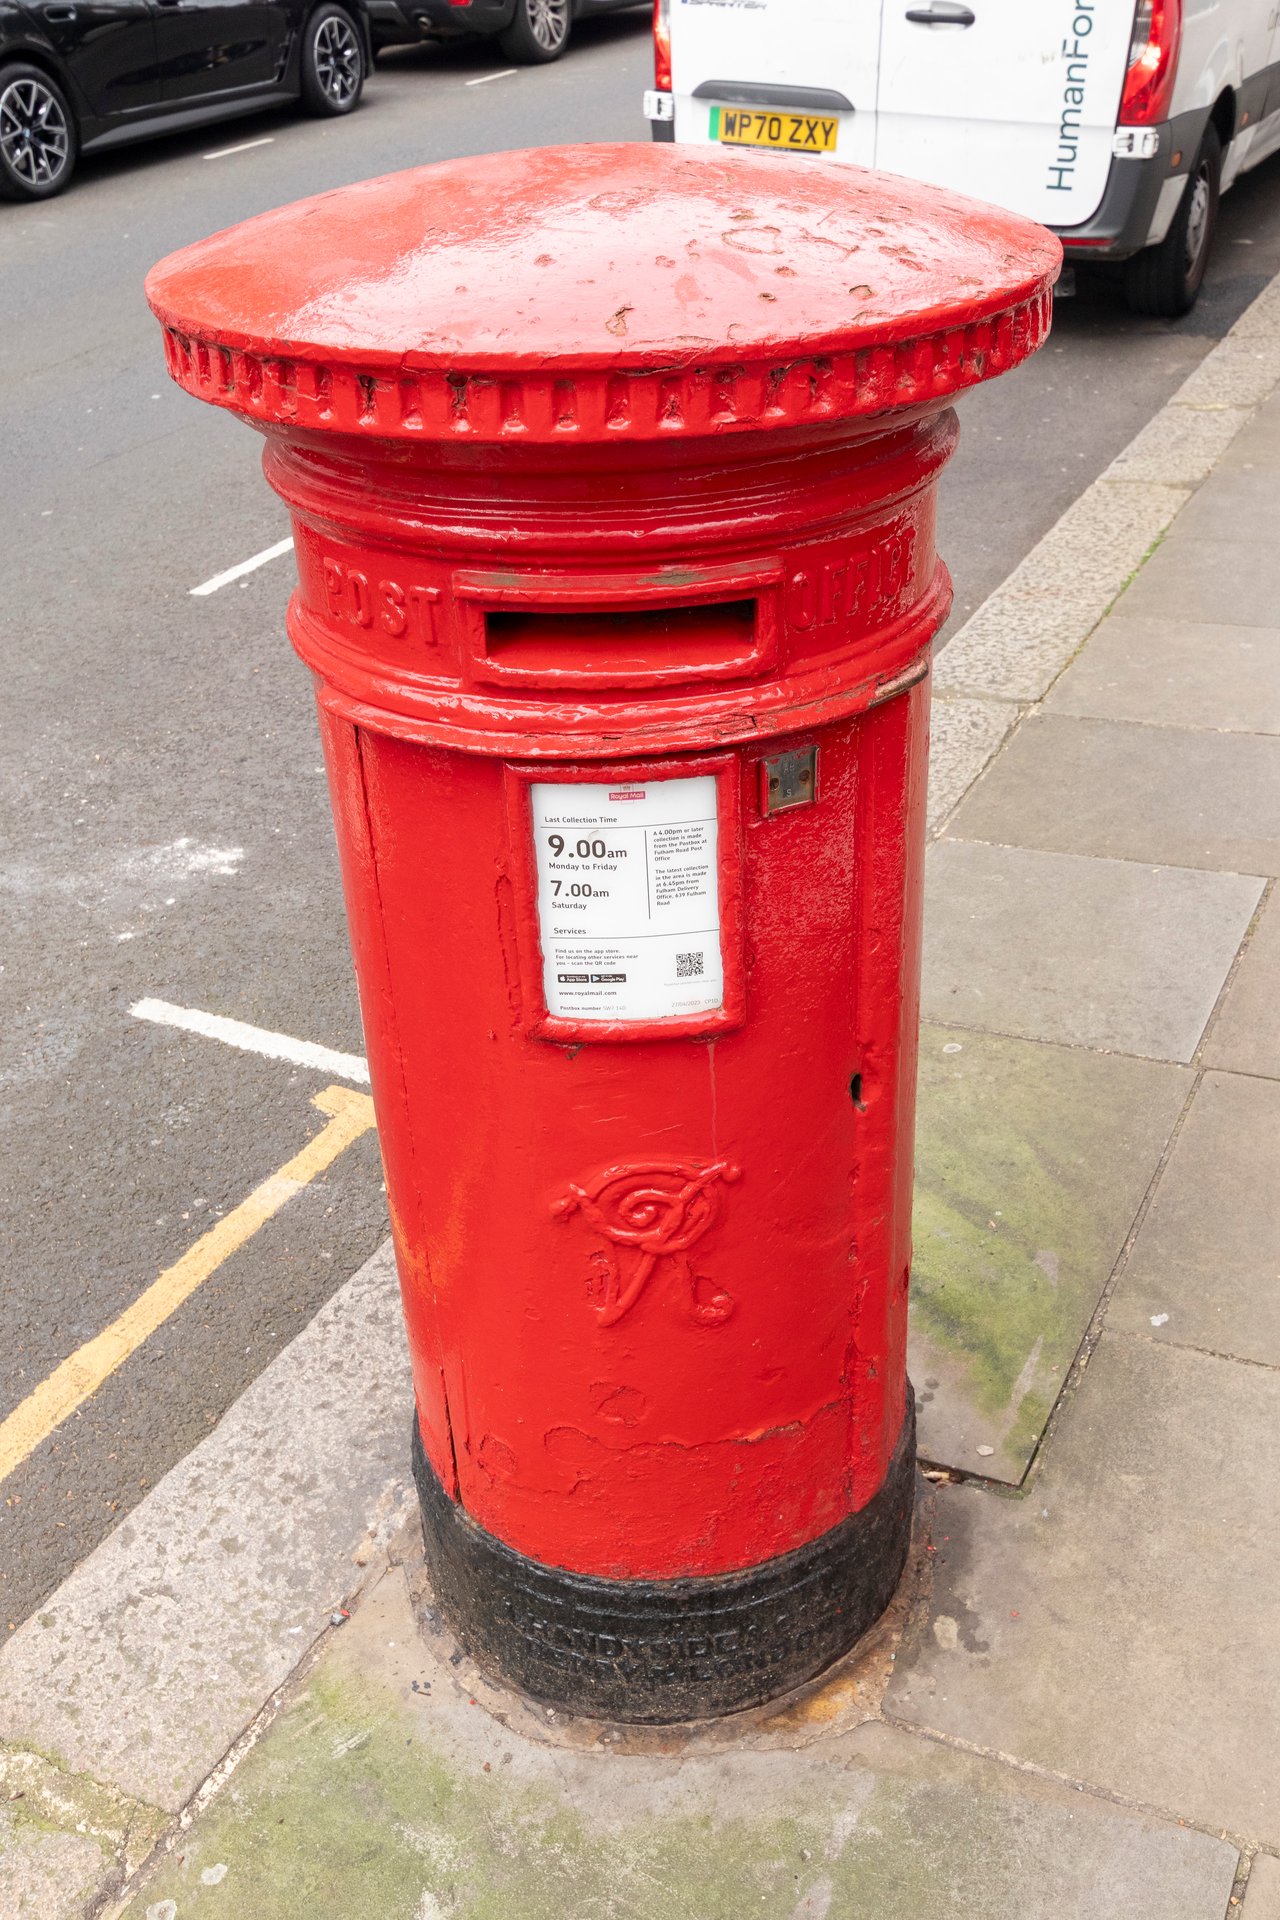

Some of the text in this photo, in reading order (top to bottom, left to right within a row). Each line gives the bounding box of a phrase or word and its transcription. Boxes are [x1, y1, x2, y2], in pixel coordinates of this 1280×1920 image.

[724, 112, 834, 146] WP70 ZXY
[323, 556, 441, 647] POST
[548, 834, 627, 858] 9.00am
[549, 862, 580, 871] Monday
[550, 880, 609, 897] 7.00am
[552, 902, 587, 910] Saturday
